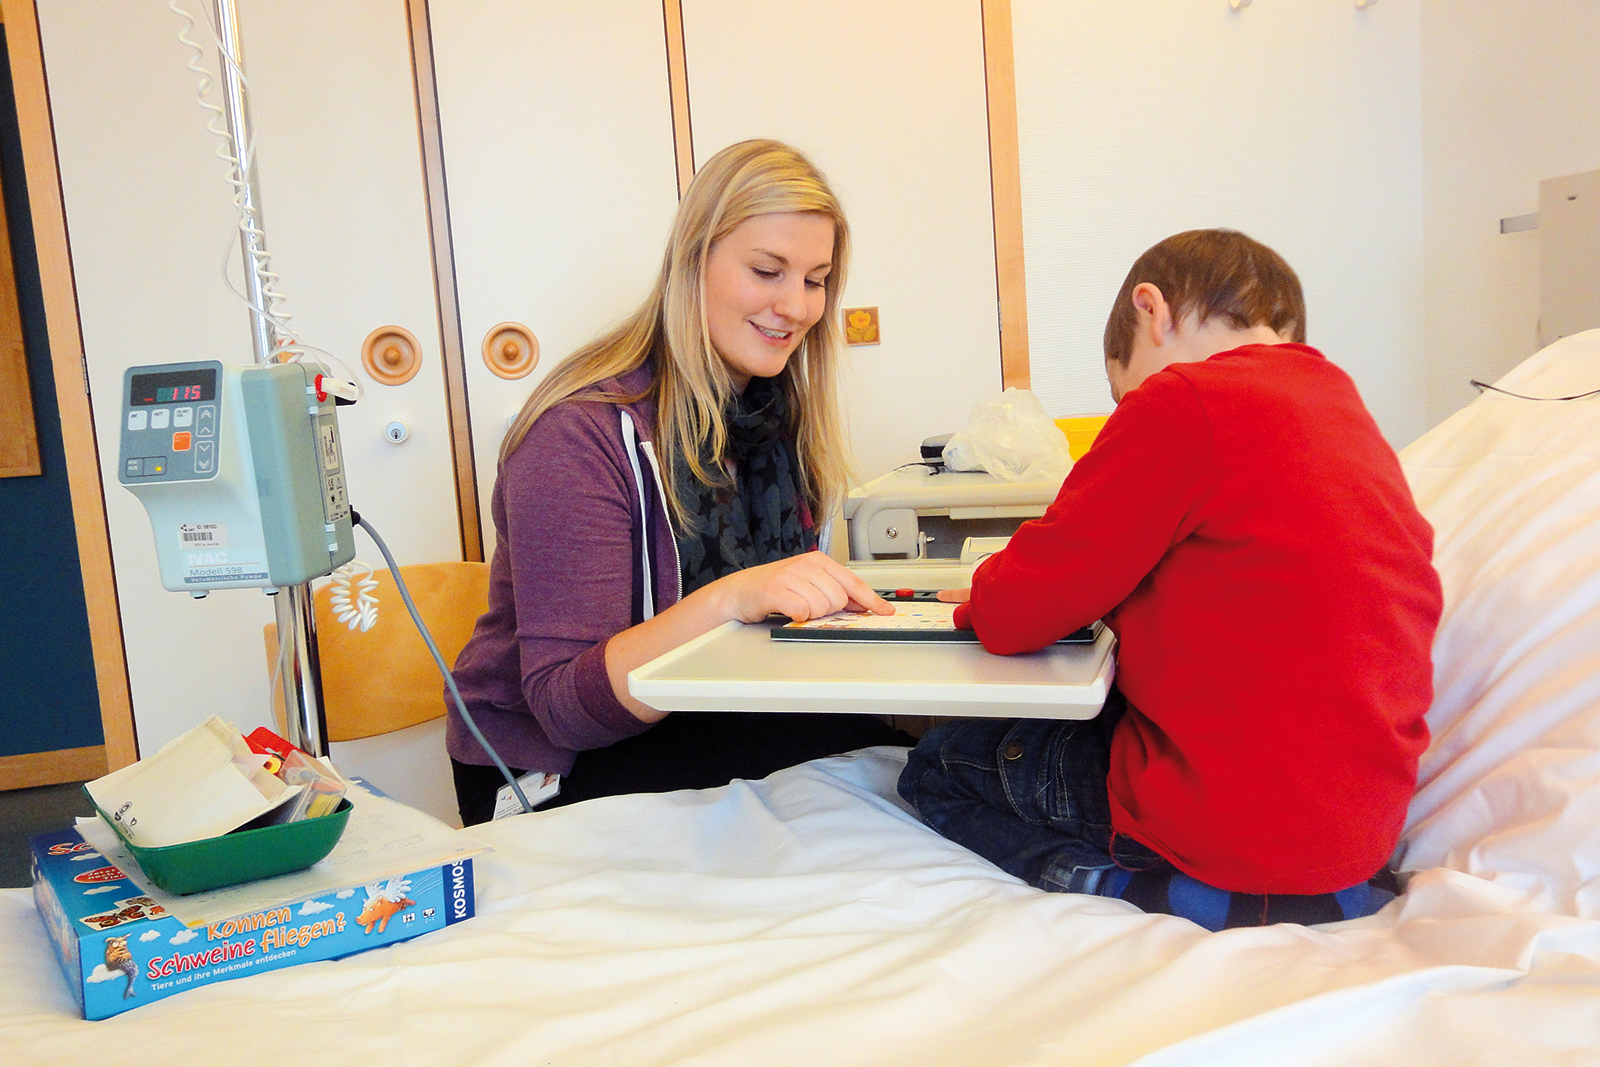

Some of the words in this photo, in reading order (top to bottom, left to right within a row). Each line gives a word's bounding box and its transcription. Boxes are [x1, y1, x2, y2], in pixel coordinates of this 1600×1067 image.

[172, 384, 201, 400] 115
[186, 551, 228, 565] IVAC
[189, 567, 223, 576] Modell
[225, 566, 243, 574] 598
[147, 939, 256, 980] Schweine
[259, 912, 347, 952] fliegen?
[151, 980, 174, 992] Tiere
[175, 974, 193, 986] und
[194, 970, 211, 981] ihre
[213, 959, 254, 976] Merkmale
[255, 949, 297, 965] entdecken
